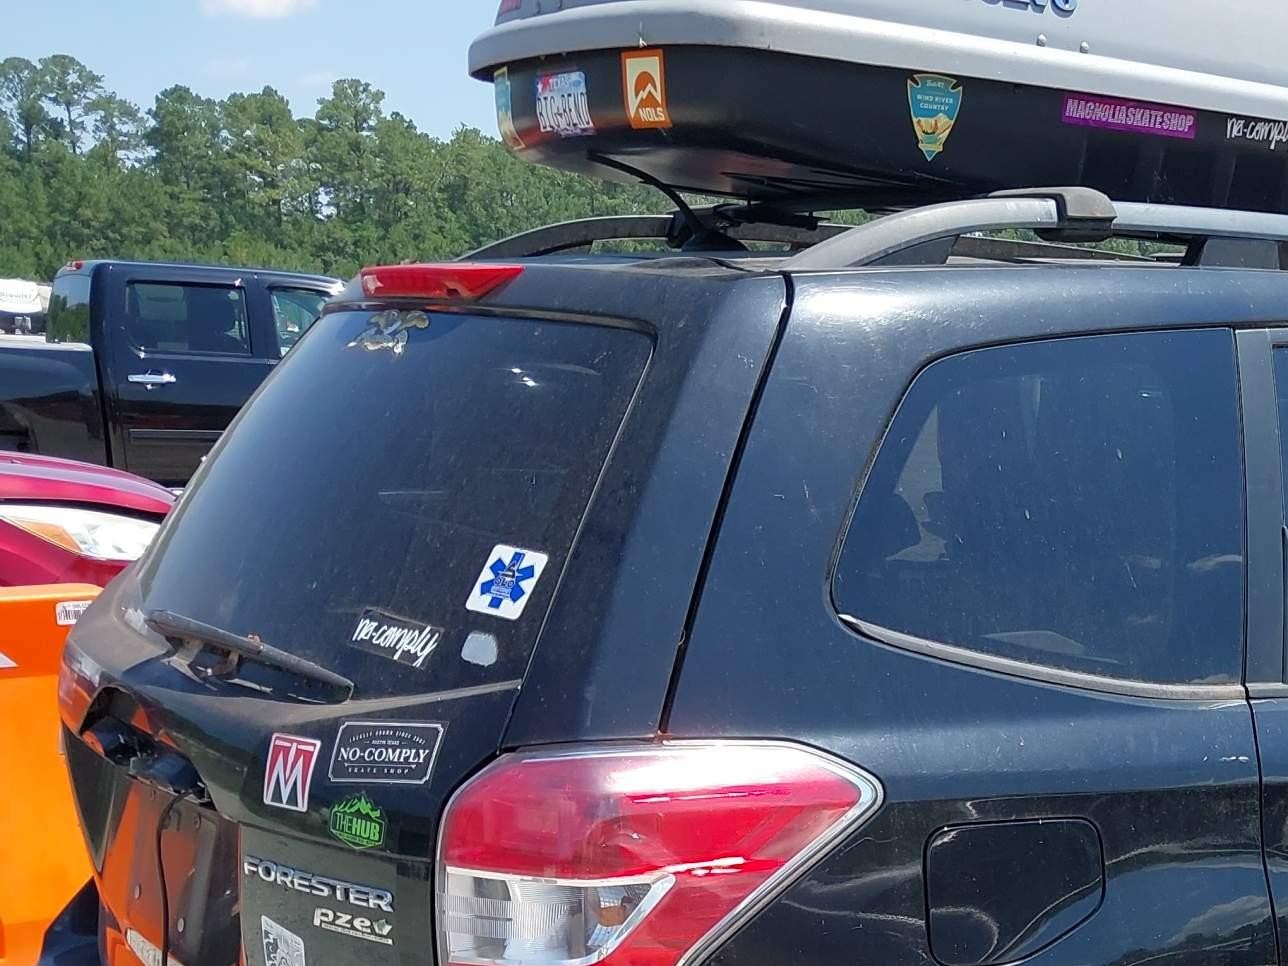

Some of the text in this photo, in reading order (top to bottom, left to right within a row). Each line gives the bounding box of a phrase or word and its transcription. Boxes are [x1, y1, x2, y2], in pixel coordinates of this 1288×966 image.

[537, 93, 592, 129] BIG BEND
[638, 107, 665, 122] NOLS
[352, 617, 438, 667] no-comply
[338, 746, 430, 763] NO-COMPLY
[243, 857, 394, 912] FORESTER
